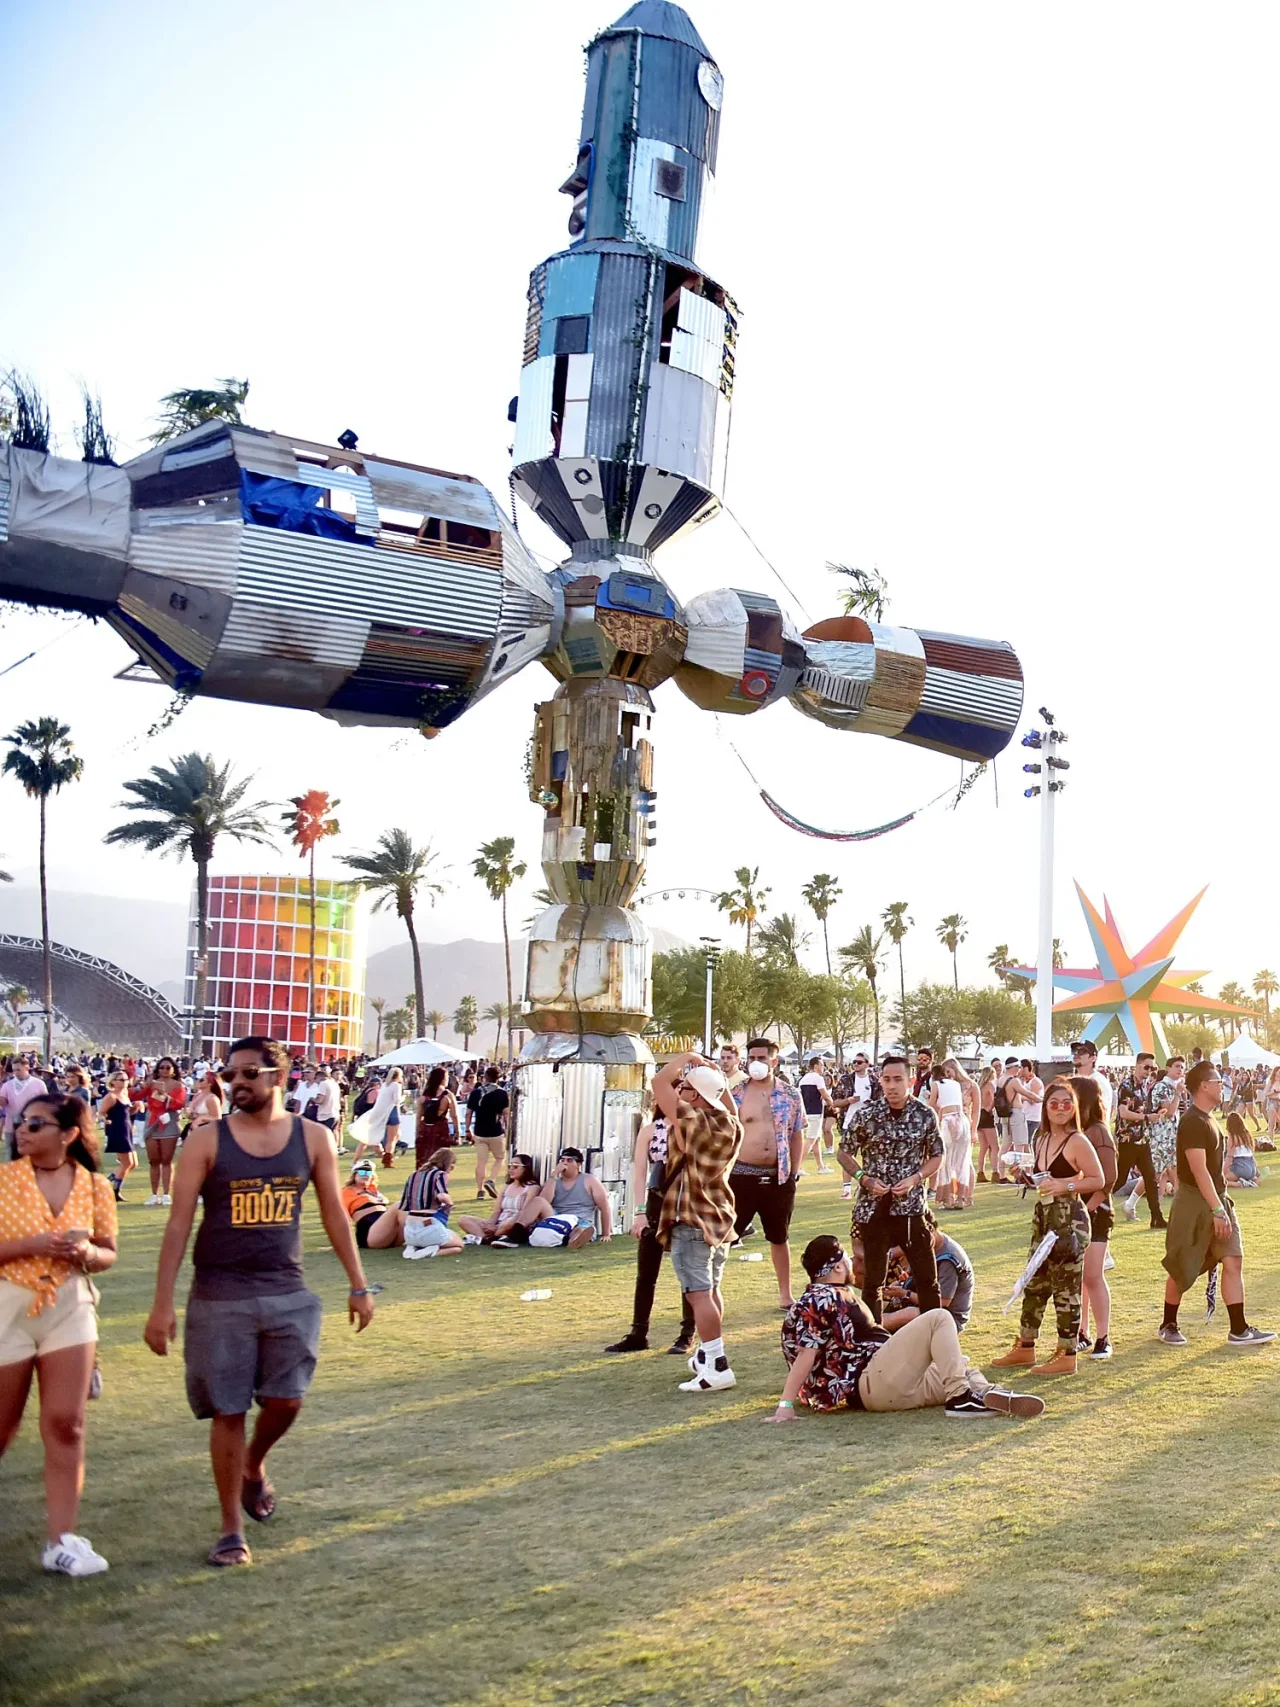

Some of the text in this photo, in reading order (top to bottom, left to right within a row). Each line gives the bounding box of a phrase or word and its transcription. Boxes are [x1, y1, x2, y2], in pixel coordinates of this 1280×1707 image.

[230, 1176, 302, 1189] BOYS WHO
[231, 1184, 298, 1225] BOOZE
